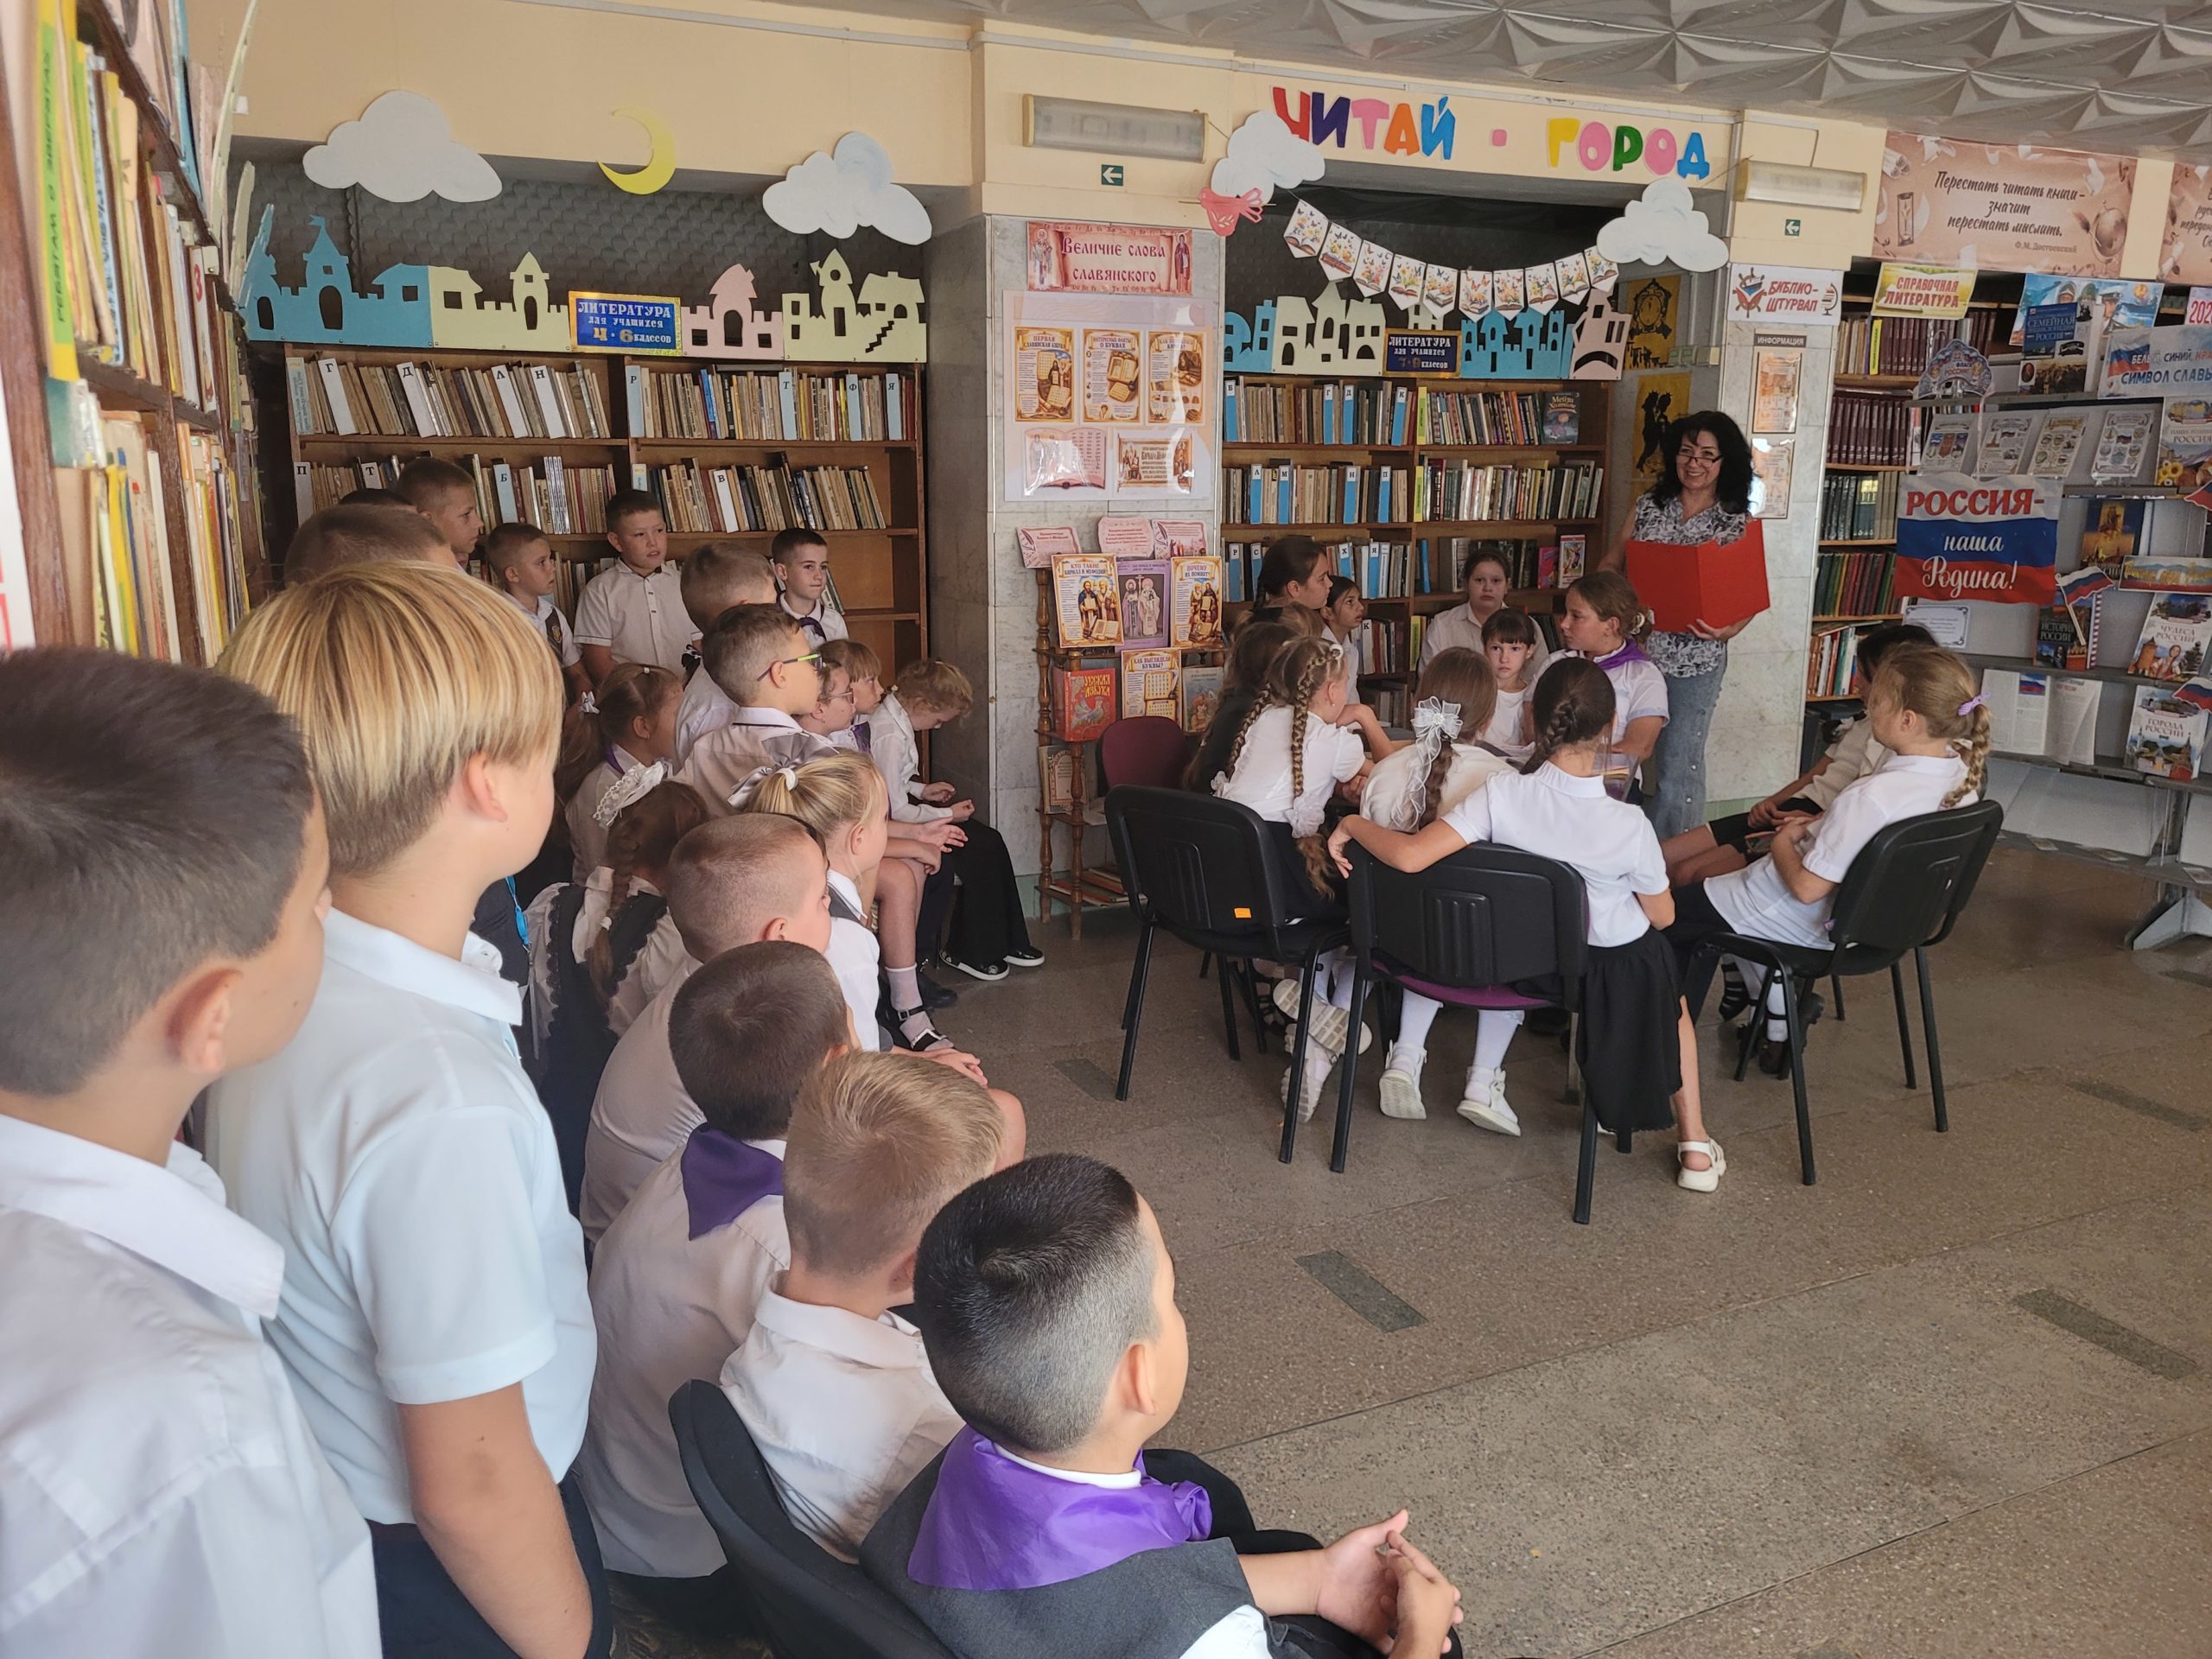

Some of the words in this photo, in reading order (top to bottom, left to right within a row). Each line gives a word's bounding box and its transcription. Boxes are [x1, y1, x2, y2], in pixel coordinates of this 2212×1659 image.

[1273, 86, 1456, 161] ЧИТАЙ
[1548, 118, 1710, 181] ГОРОД
[1935, 171, 1999, 195] Перестать
[2003, 182, 2044, 198] читать
[1984, 200, 2031, 218] значит
[1948, 216, 2010, 234] перестать
[2012, 224, 2063, 237] мыслить.
[1896, 276, 1960, 293] СПРАВОЧНАЯ
[1765, 297, 1819, 313] ШТУРВАЛ
[1885, 290, 1960, 308] ЛИТЕРАТУРА
[578, 302, 671, 318] ЛИТЕРАТУРА
[1389, 336, 1451, 346] ЛИТЕРАТУРА
[1758, 336, 1804, 346] ИНФОРМАЦИЯ
[403, 366, 413, 378] Д
[536, 370, 547, 379] Н
[2121, 370, 2170, 385] СИМВОЛ
[629, 375, 638, 385] Р
[783, 381, 791, 390] Т
[849, 383, 858, 391] Ф
[887, 382, 896, 391] Я
[296, 466, 307, 476] П
[365, 467, 374, 475] Т
[500, 474, 508, 482] Б
[717, 474, 726, 483] В
[1906, 488, 2044, 516] РОССИЯ-
[1944, 535, 2004, 552] наша
[1922, 556, 2018, 598] Родина!
[2161, 625, 2195, 636] ЧУДЕСА
[2148, 718, 2183, 730] ГОРОДА
[2145, 724, 2183, 737] РОССИИ
